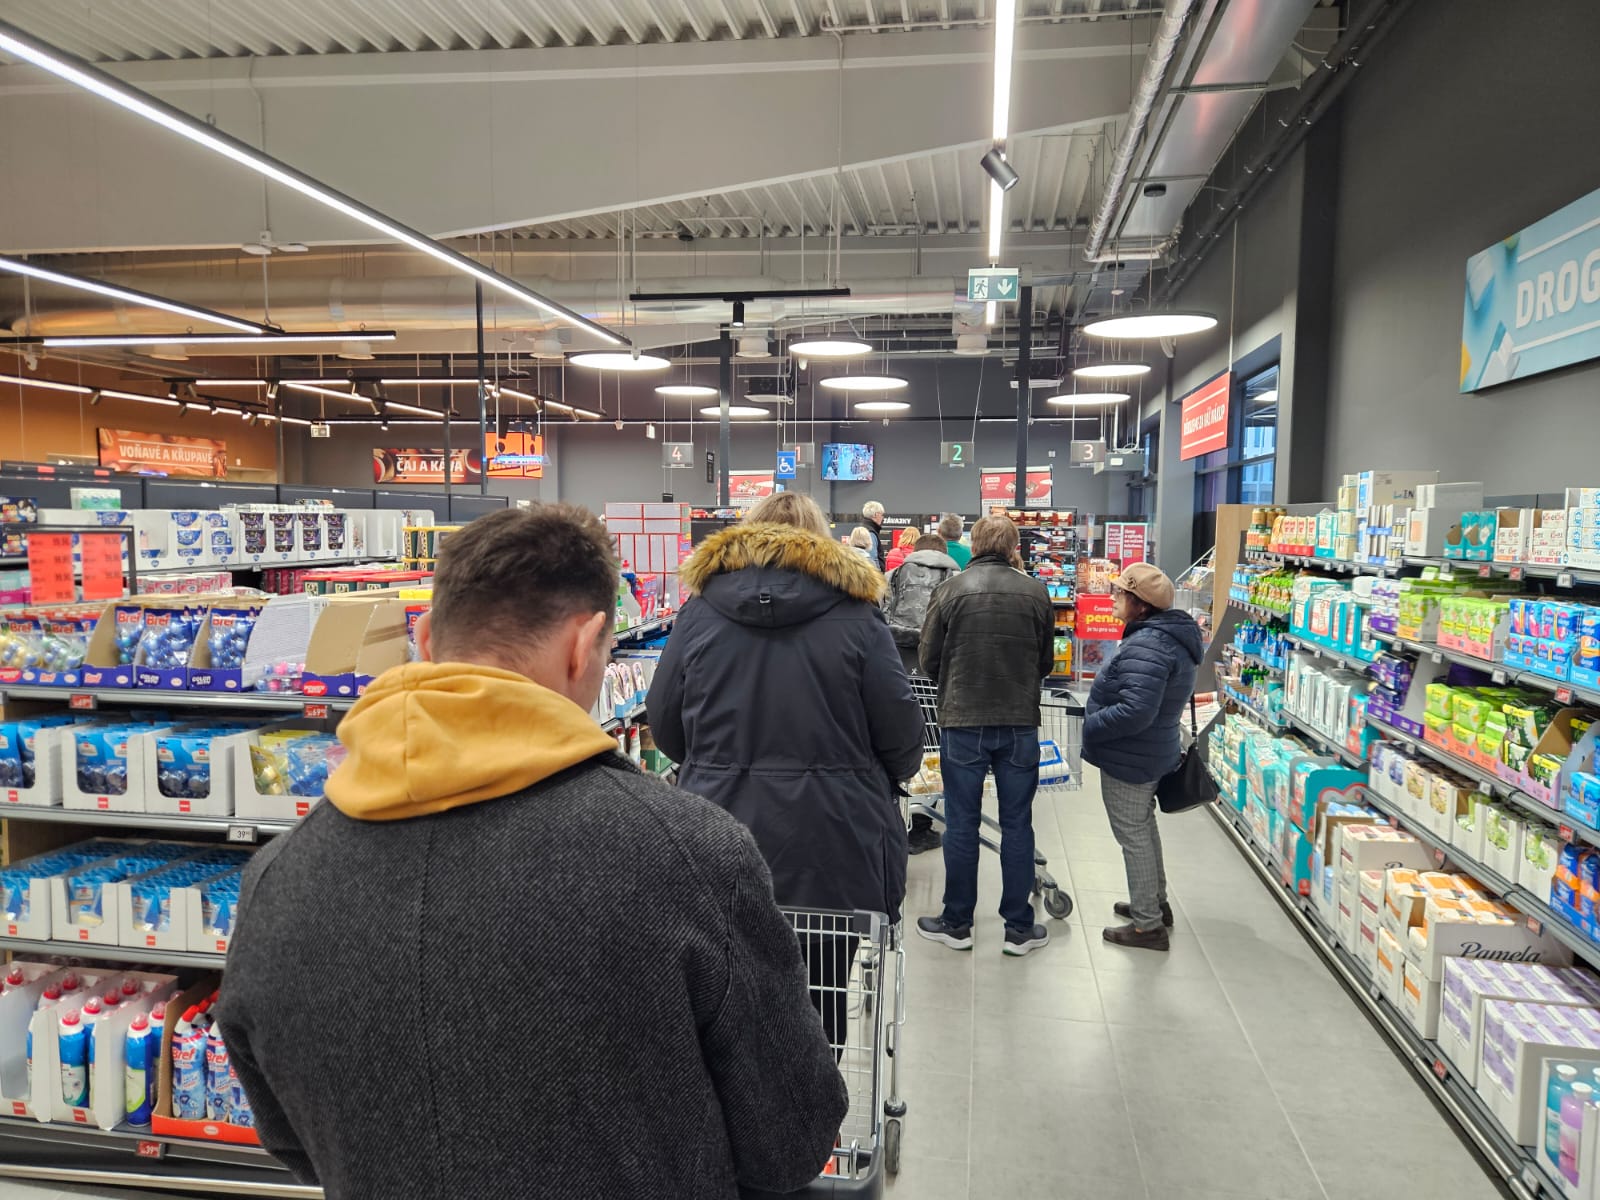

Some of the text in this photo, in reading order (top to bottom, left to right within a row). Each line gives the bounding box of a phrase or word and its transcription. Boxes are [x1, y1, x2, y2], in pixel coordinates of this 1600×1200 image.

[119, 444, 213, 464] VOŇAVÉ A KŘUPAVÉ
[672, 446, 683, 461] 4
[795, 446, 801, 462] 1
[952, 444, 963, 461] 2
[1083, 444, 1094, 460] 3
[396, 456, 417, 472] ČAJ
[419, 461, 428, 472] A
[118, 611, 142, 623] Bref
[145, 613, 171, 626] Bref
[212, 614, 236, 627] Bref
[10, 622, 33, 632] Bref
[52, 623, 75, 633] Bref
[1460, 941, 1541, 962] Pamela
[172, 1046, 196, 1060] Bref
[206, 1049, 229, 1063] Bref
